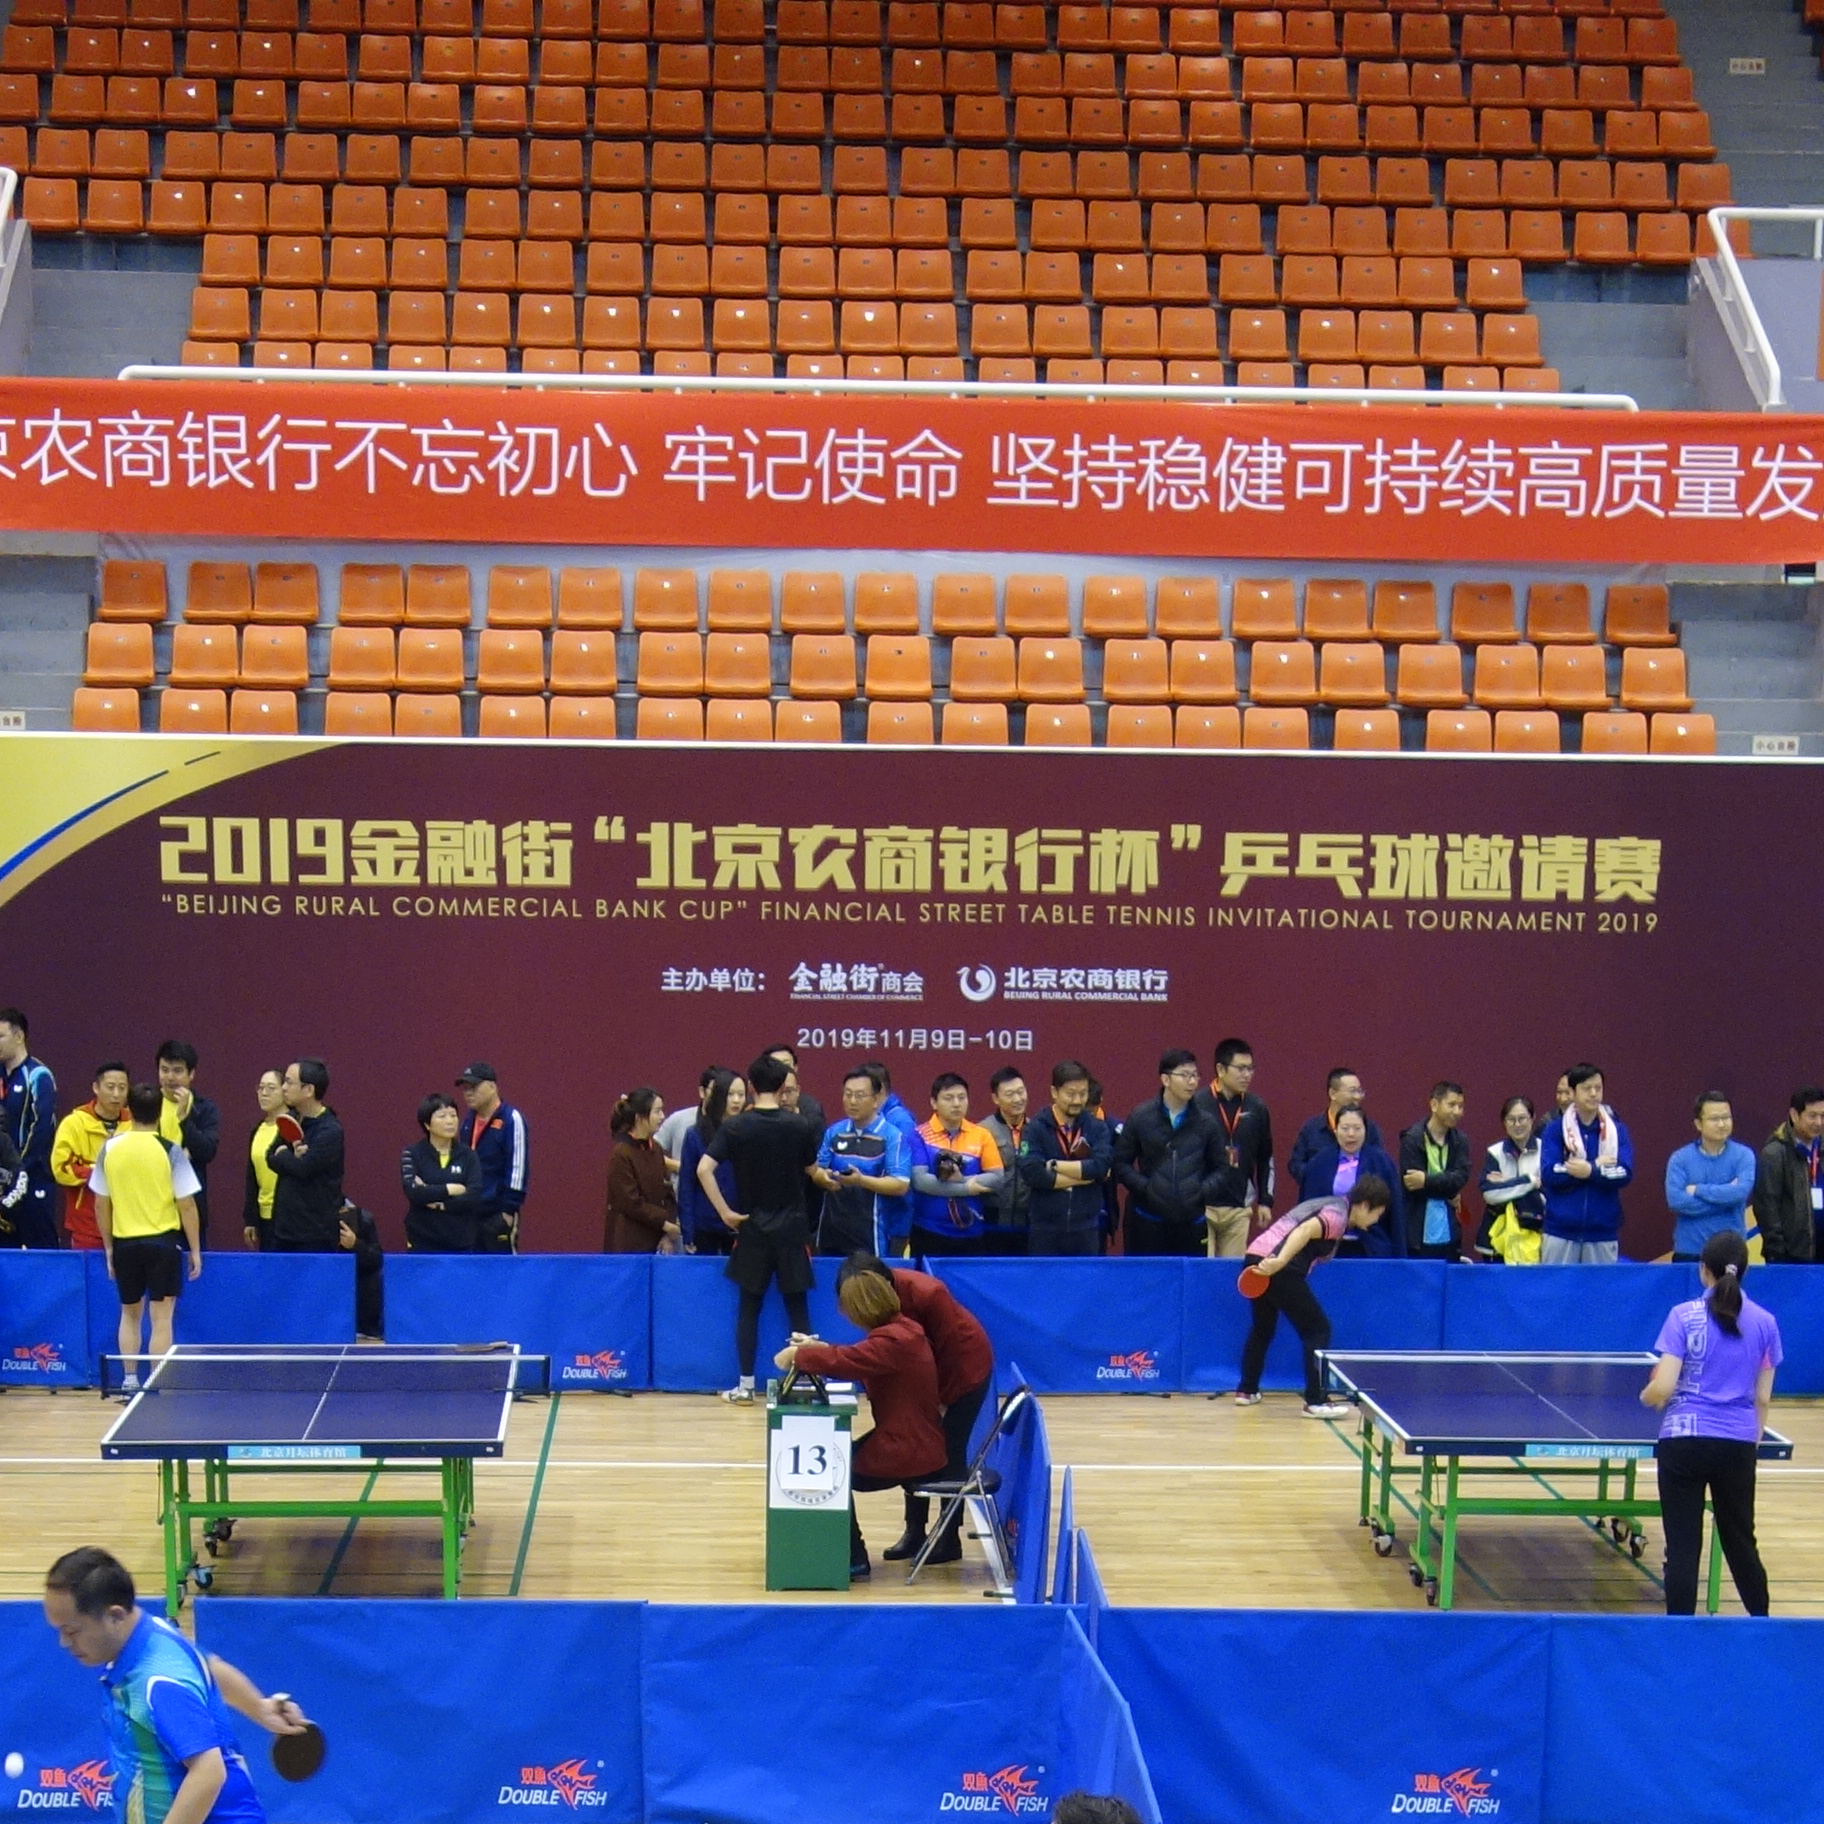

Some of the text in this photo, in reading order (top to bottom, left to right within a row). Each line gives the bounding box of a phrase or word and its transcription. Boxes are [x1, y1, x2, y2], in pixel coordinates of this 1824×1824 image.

[663, 424, 963, 507] 牢记使命
[295, 896, 380, 917] RURAL
[392, 897, 583, 919] COMMERCIAL
[596, 900, 666, 920] BANK
[761, 902, 906, 923] FINANCIAL
[920, 903, 1006, 923] STREET
[1019, 904, 1094, 925] TABLE
[1107, 905, 1195, 927] TENNIS
[1209, 907, 1393, 930] INVITATIONAL
[1406, 909, 1586, 932] TOURNAMENT
[1598, 912, 1659, 934] 2019
[661, 967, 765, 992] 主办单位：
[1004, 967, 1168, 991] 北京农商银行
[1003, 991, 1168, 1002] BEIJING RURAL COMMERCIAL BANK
[2, 1359, 66, 1372] DOUBLE FISH
[562, 1366, 628, 1380] DOUBLE FISH
[1097, 1366, 1160, 1379] DOUBLE FISH
[788, 1444, 828, 1475] 13
[17, 1789, 115, 1809] DOUBLE FIS
[497, 1785, 608, 1806] DOUBLE FISH
[939, 1792, 1049, 1813] DOUBLE FISH
[1391, 1794, 1502, 1815] DOUBLE FISH
